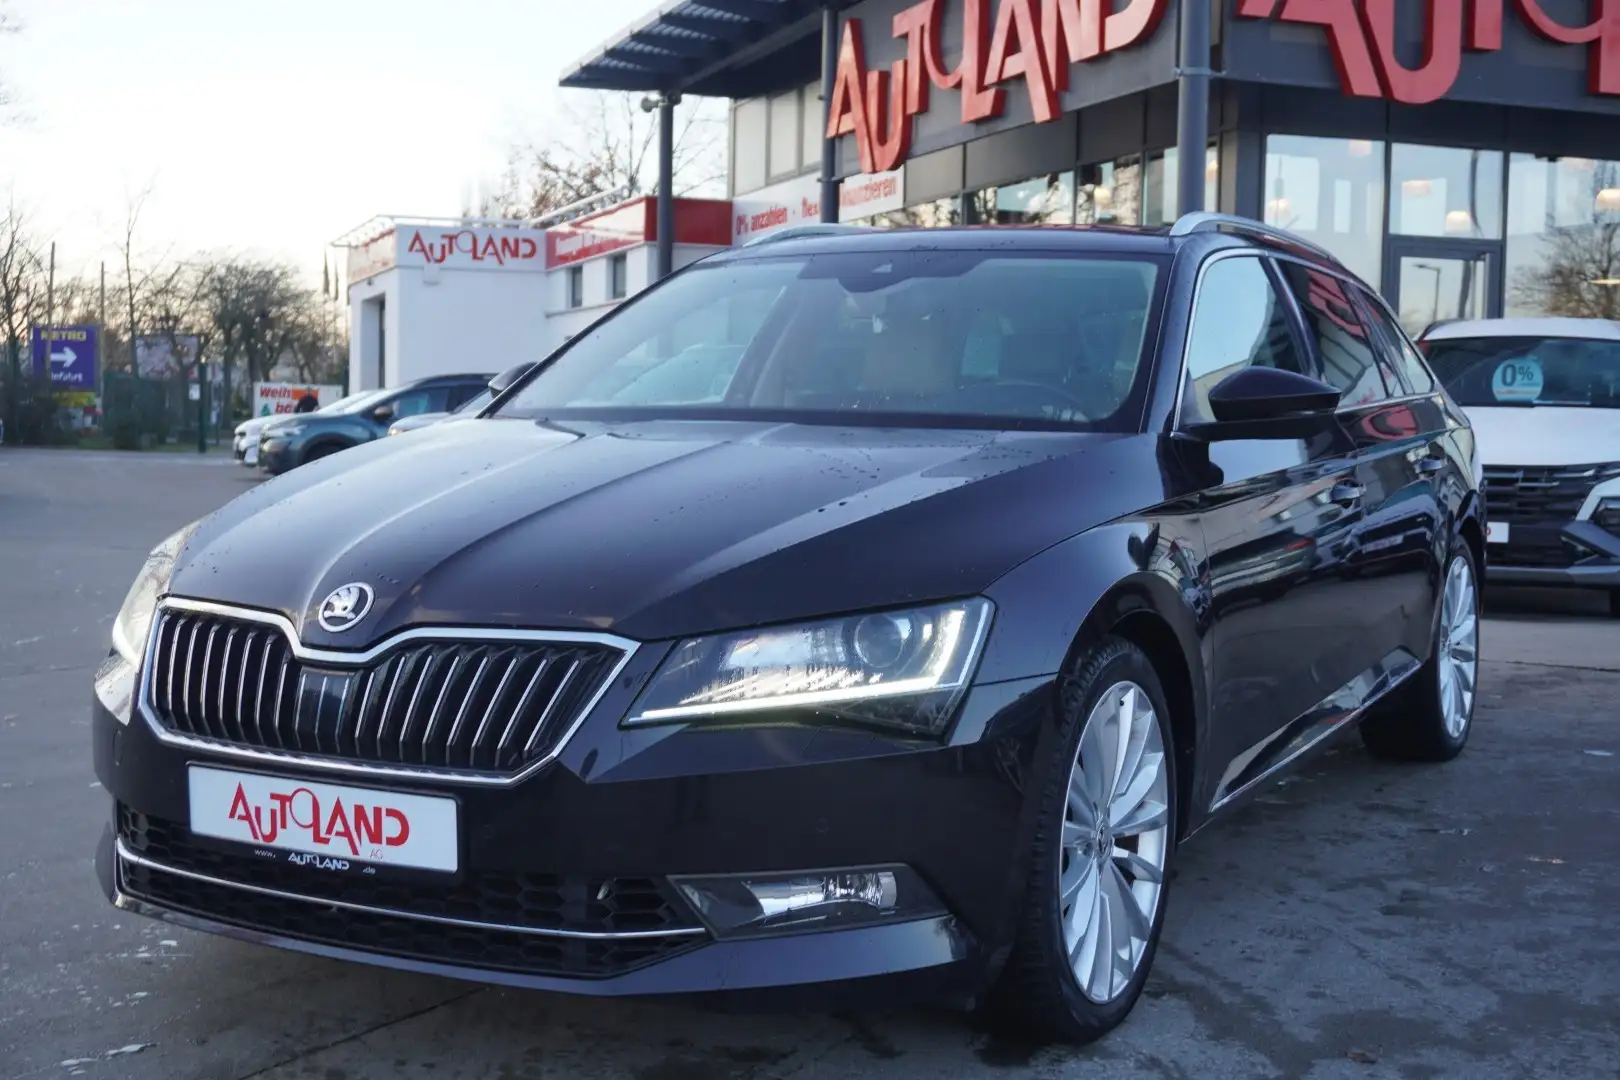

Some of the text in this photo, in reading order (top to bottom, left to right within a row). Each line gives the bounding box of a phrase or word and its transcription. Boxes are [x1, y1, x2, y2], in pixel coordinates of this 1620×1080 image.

[408, 230, 537, 265] AUTOLAND
[1501, 364, 1534, 387] 0%
[228, 781, 410, 856] AUTOLAND
[288, 852, 350, 871] AUTOLAND
[363, 866, 376, 875] .de
